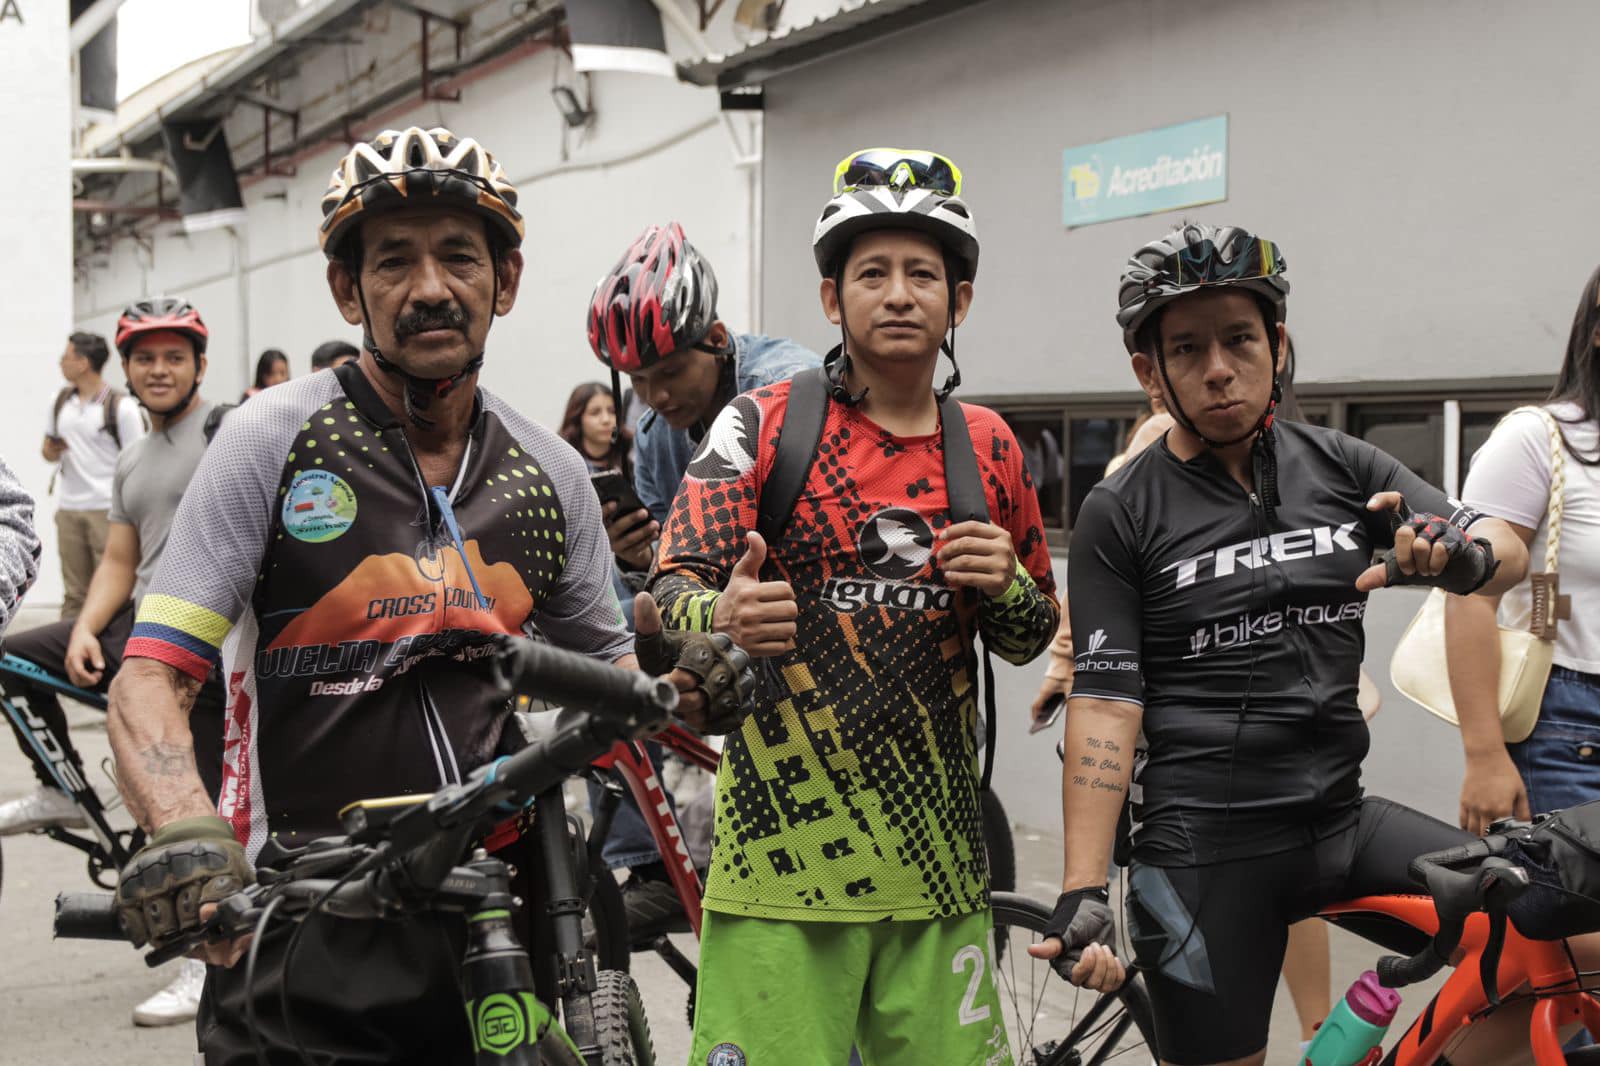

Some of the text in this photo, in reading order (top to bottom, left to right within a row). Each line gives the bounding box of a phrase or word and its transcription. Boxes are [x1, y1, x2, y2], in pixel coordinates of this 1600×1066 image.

[1107, 145, 1223, 199] Acreditación
[1159, 520, 1360, 589] TREK
[366, 592, 437, 620] CROSS
[309, 674, 385, 697] Desde la
[1080, 756, 1096, 767] Mi
[1072, 775, 1088, 785] Mi
[952, 944, 991, 1026] 2
